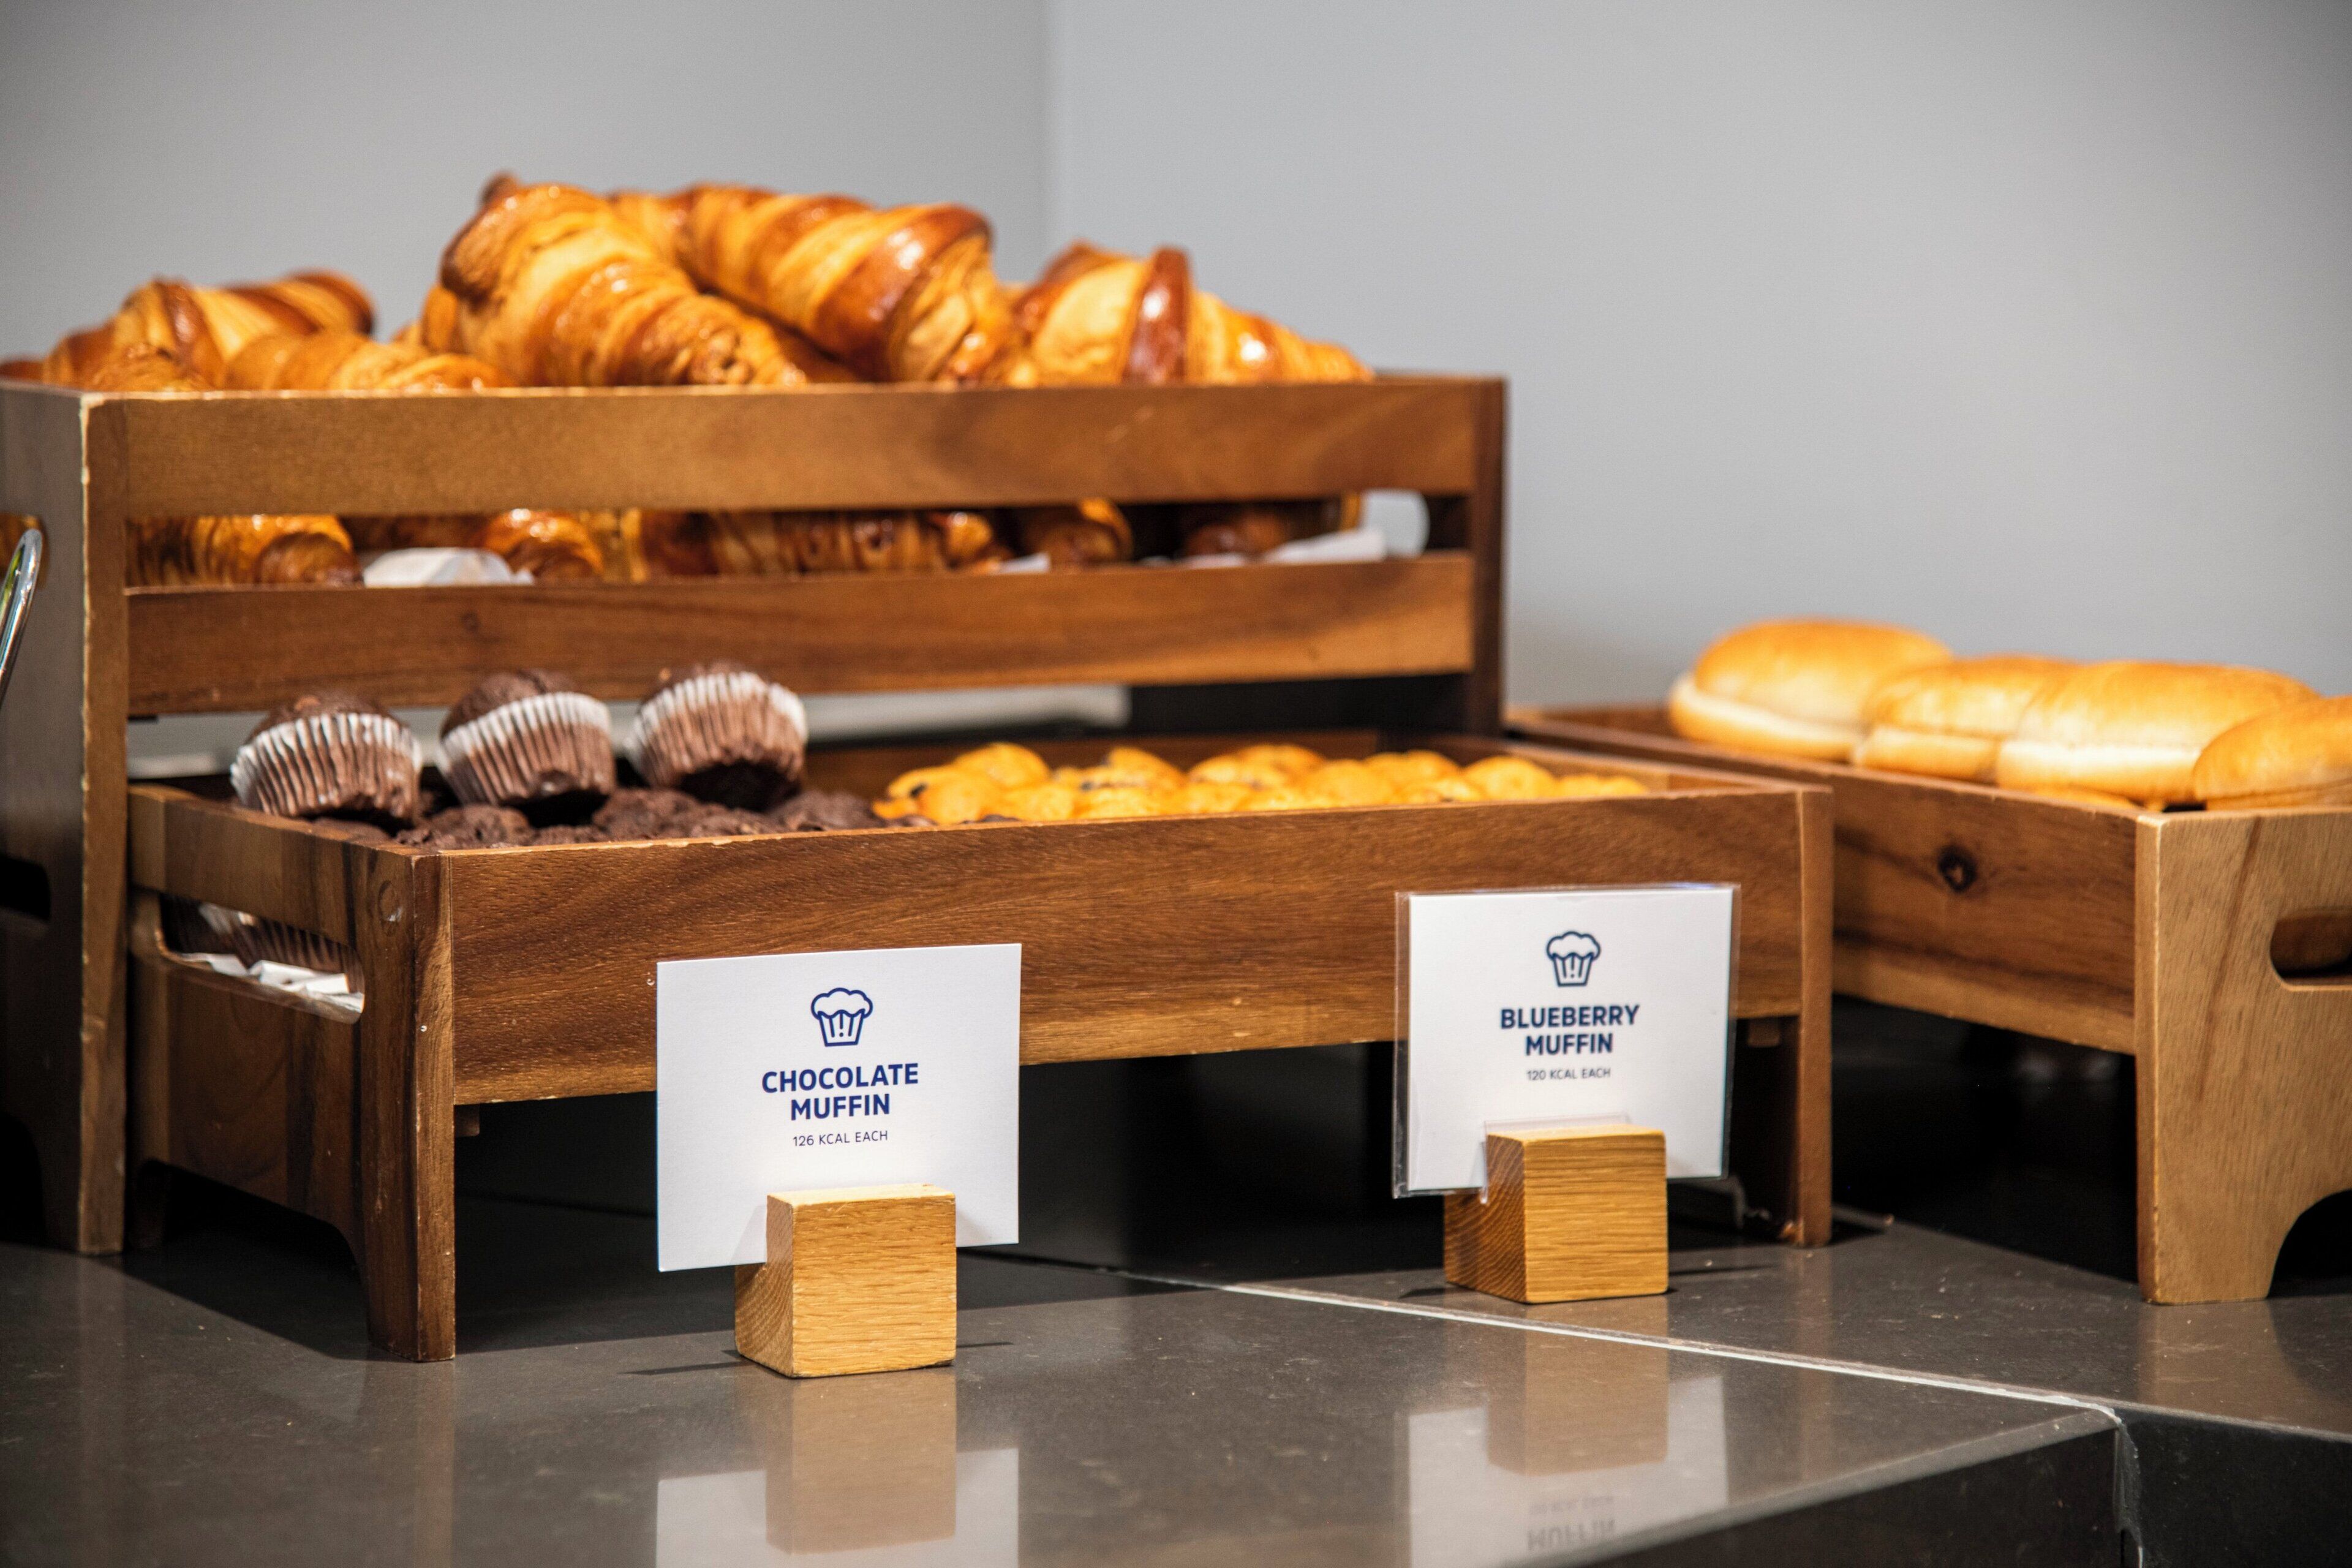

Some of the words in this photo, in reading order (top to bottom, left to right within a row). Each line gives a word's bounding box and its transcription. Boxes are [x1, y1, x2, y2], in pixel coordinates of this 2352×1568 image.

[1500, 1004, 1640, 1030] BLUEBERRY
[1525, 1032, 1613, 1056] MUFFIN
[761, 1063, 919, 1093] CHOCOLATE
[1526, 1070, 1547, 1081] 120
[1550, 1068, 1577, 1079] KCAL
[1581, 1067, 1611, 1079] EACH
[791, 1093, 890, 1121] MUFFIN
[793, 1135, 814, 1147] 126
[819, 1133, 850, 1145] KCAL
[855, 1130, 888, 1143] EACH
